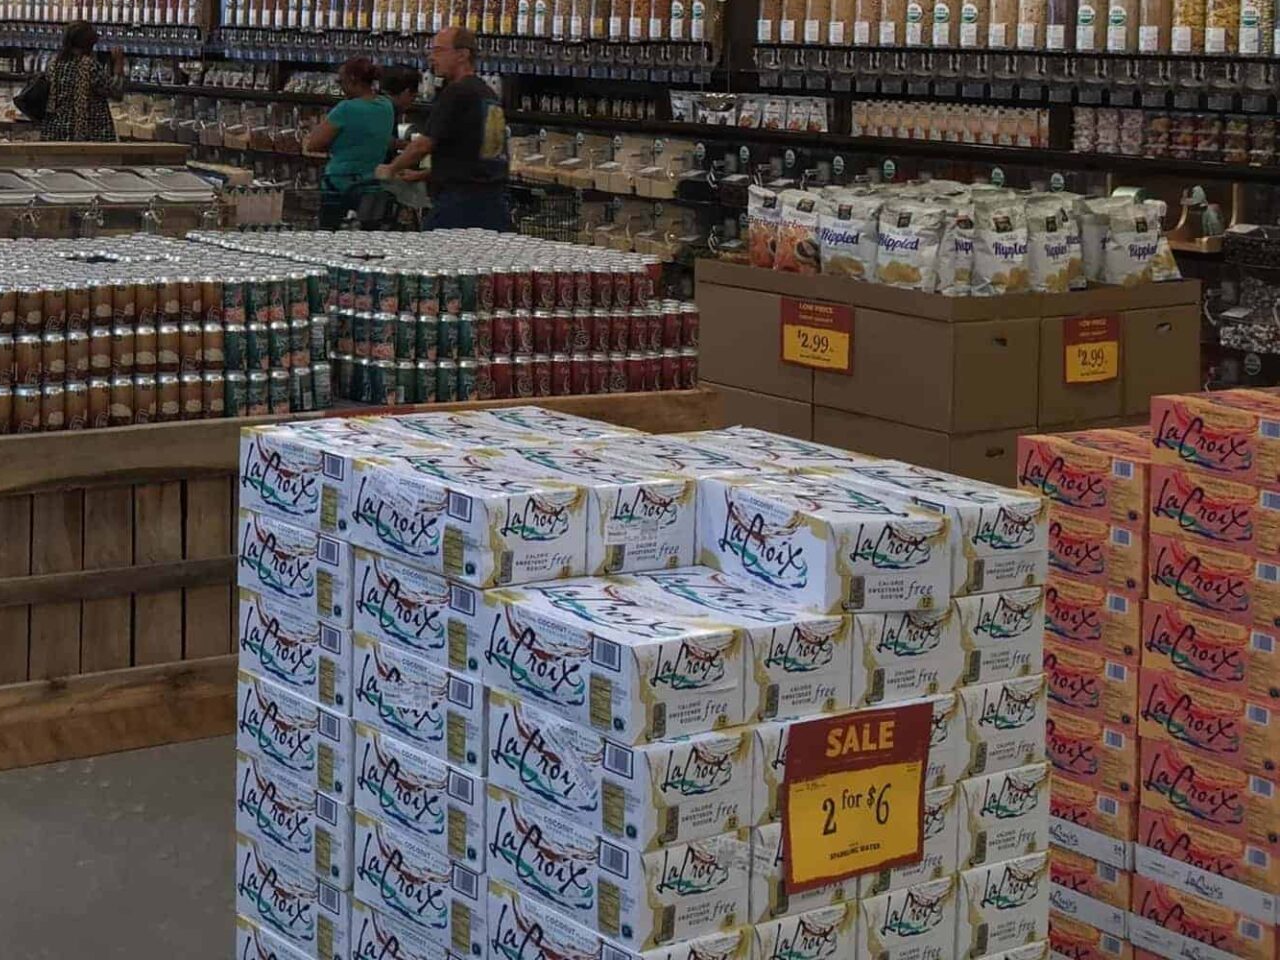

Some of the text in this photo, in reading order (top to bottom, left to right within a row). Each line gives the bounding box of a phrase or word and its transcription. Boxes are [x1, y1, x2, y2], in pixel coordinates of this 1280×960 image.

[1153, 410, 1246, 463] LaCroix
[241, 442, 315, 504] LaCroix
[1019, 449, 1101, 501] LaCroix
[500, 496, 564, 537] LaCroix
[611, 487, 673, 522] LaCroix
[972, 507, 1033, 548] LaCroix
[1153, 479, 1248, 532] LaCroix
[240, 522, 310, 587] LaCroix
[718, 502, 803, 576] LaCroix
[849, 523, 927, 566] LaCroix
[357, 566, 439, 636] LaCroix
[1151, 548, 1243, 602] LaCroix
[241, 606, 312, 673] LaCroix
[876, 611, 937, 657] LaCroix
[973, 596, 1032, 637] LaCroix
[1145, 614, 1238, 672] LaCroix
[485, 613, 580, 692] LaCroix
[650, 640, 720, 689] LaCroix
[764, 622, 830, 672] LaCroix
[240, 688, 310, 758] LaCroix
[979, 686, 1034, 729] LaCroix
[1141, 684, 1234, 743] LaCroix
[825, 721, 895, 757] SALE
[358, 743, 438, 821] LaCroix
[661, 746, 728, 795] LaCroix
[980, 775, 1035, 818] LaCroix
[1143, 754, 1238, 813] LaCroix
[239, 768, 308, 839] LaCroix
[822, 783, 891, 835] 2 for $6
[357, 833, 442, 914] LaCroix
[489, 807, 587, 894] LaCroix
[238, 852, 310, 926] LaCroix
[980, 866, 1036, 908] LaCroix
[881, 891, 941, 937] LaCroix
